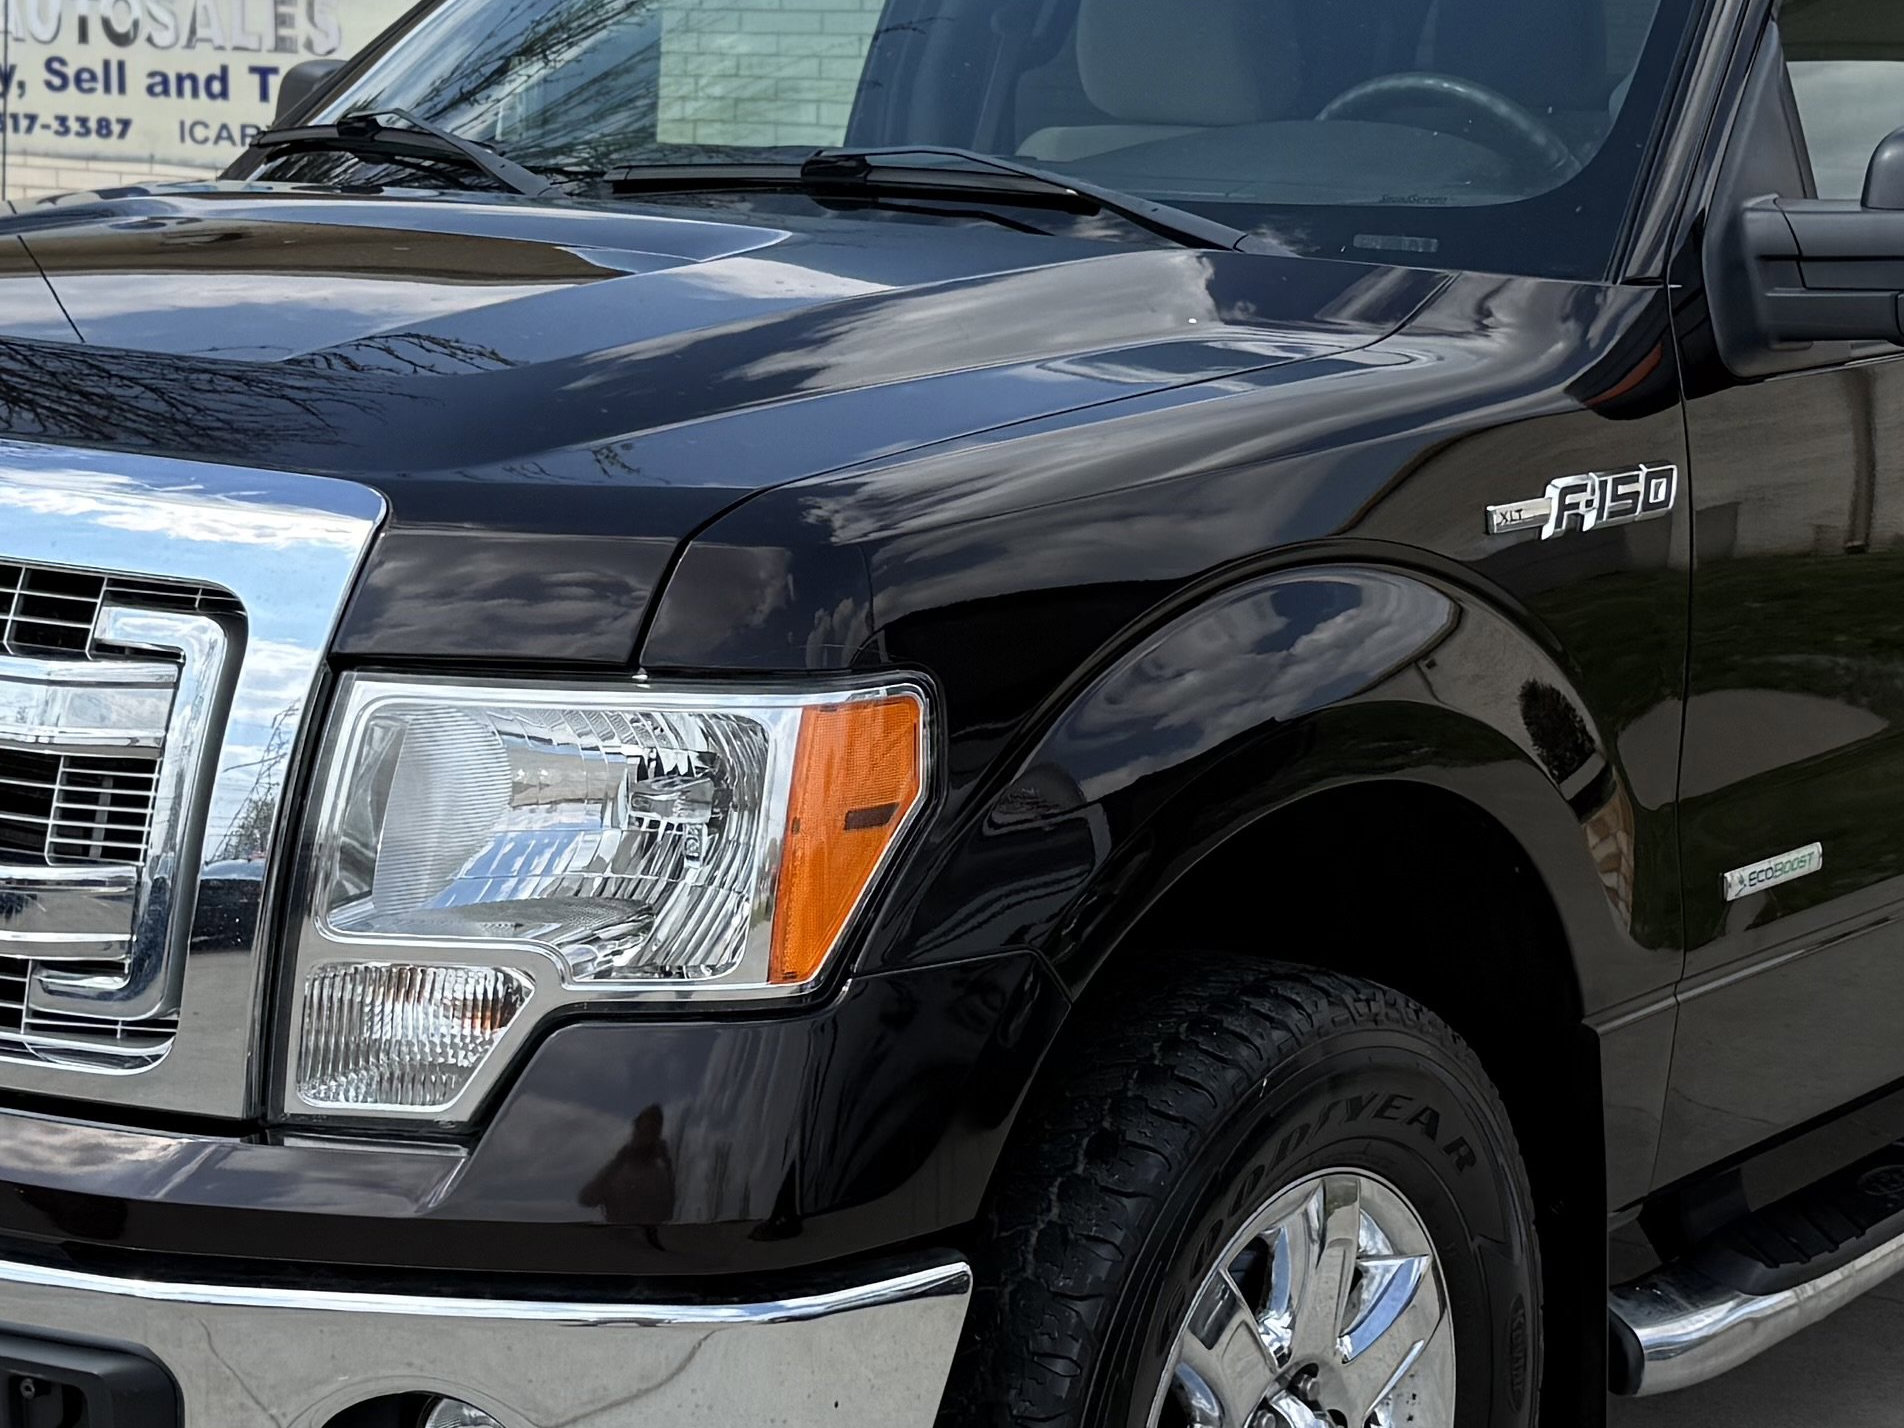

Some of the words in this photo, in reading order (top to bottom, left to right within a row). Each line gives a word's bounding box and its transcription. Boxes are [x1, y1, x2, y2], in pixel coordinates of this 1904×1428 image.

[43, 55, 127, 96] Sell
[145, 63, 230, 102] and
[248, 65, 280, 104] T
[179, 119, 264, 148] ICAR
[1499, 507, 1524, 526] XLT
